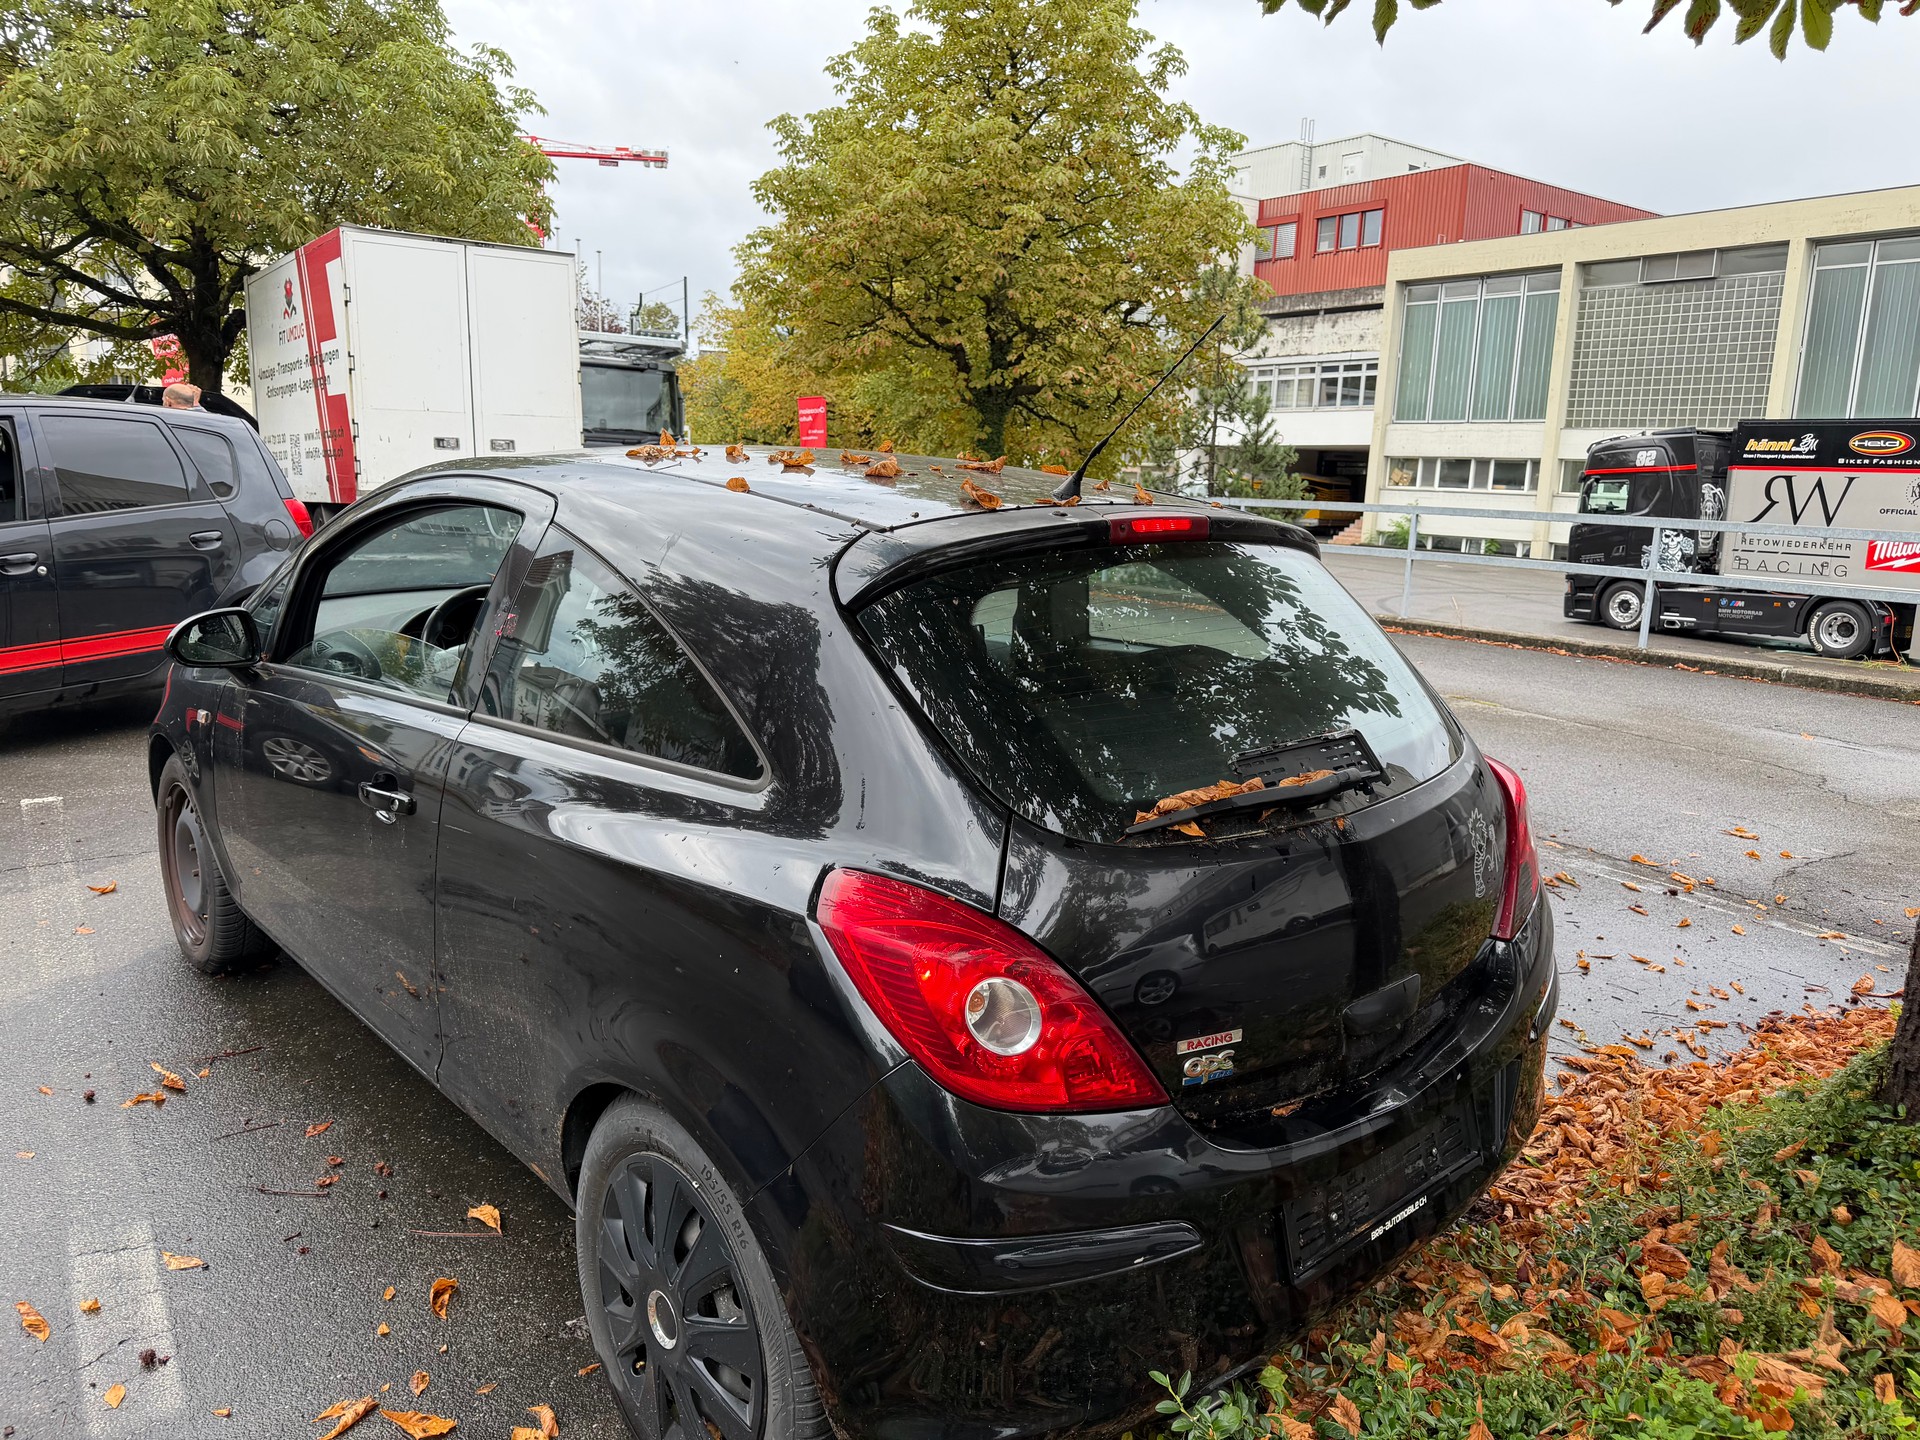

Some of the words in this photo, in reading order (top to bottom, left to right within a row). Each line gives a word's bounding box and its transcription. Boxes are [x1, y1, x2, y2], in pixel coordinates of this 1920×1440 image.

[278, 329, 286, 346] FIT
[286, 322, 305, 343] UMZUG
[276, 357, 303, 376] -Transporte
[1744, 438, 1796, 451] hänni
[1854, 439, 1900, 447] Held
[1838, 457, 1869, 465] BIKER
[1879, 508, 1918, 516] OFFICIAL
[1738, 557, 1848, 578] RACING
[1732, 608, 1763, 616] MOTORRAD
[1186, 1031, 1233, 1051] RACING
[700, 1163, 733, 1215] 195/55
[731, 1219, 750, 1250] R16
